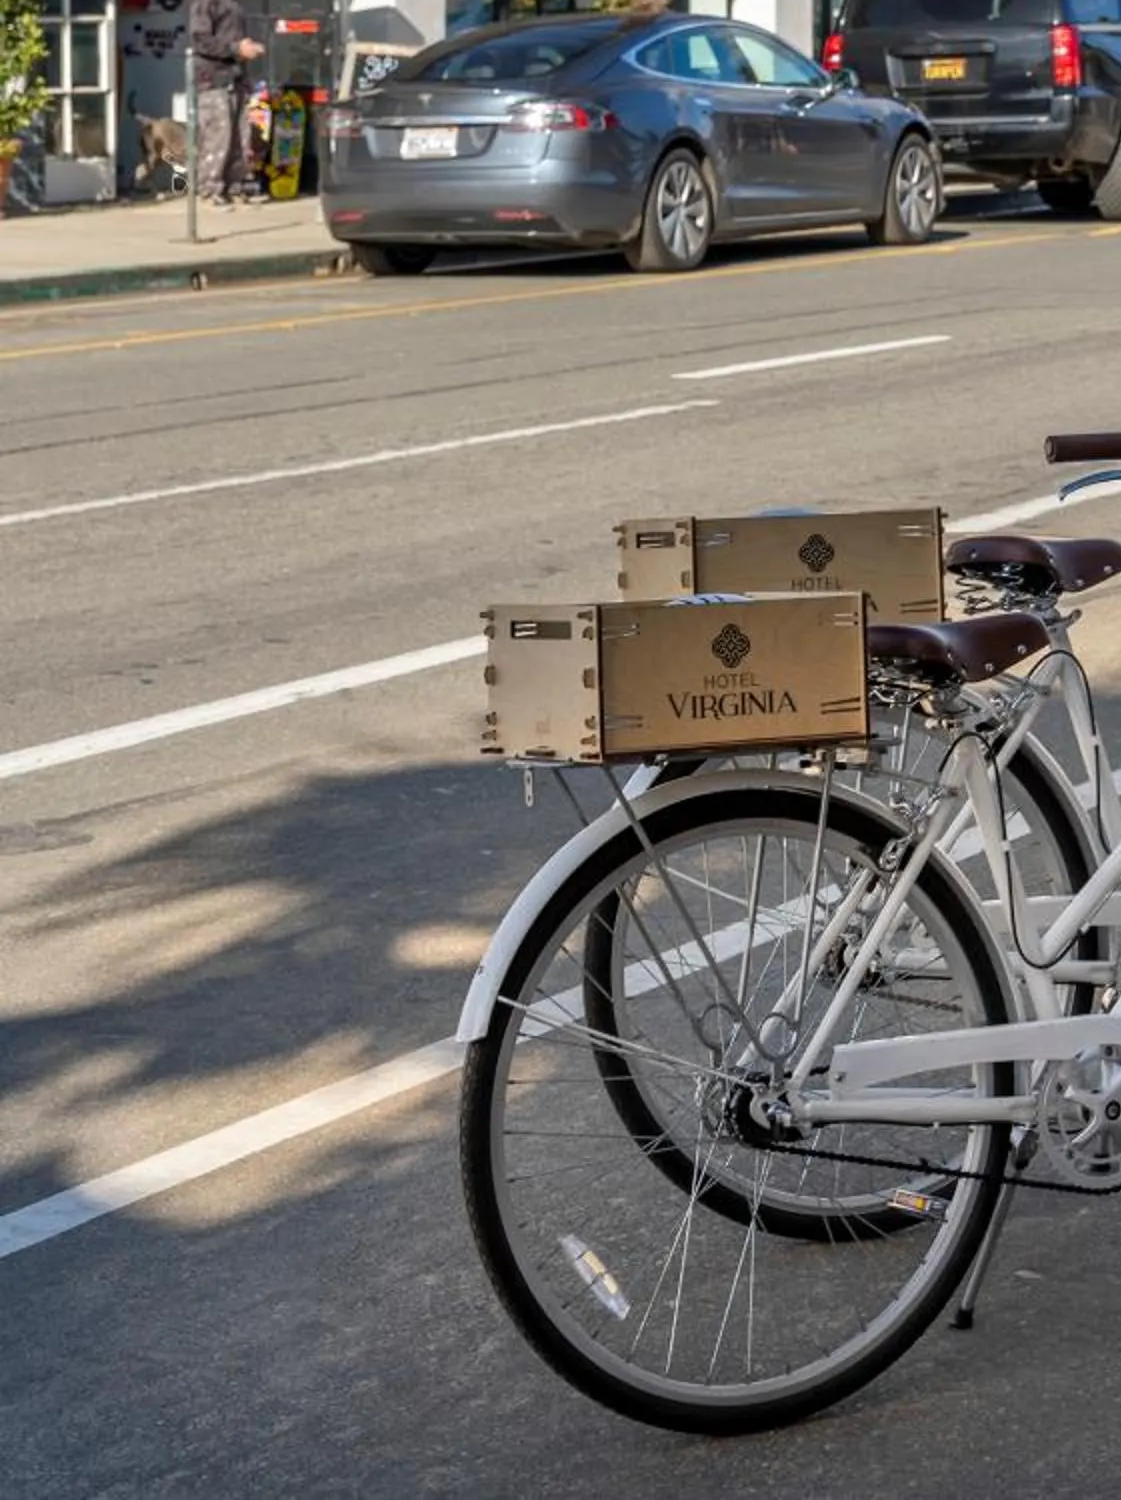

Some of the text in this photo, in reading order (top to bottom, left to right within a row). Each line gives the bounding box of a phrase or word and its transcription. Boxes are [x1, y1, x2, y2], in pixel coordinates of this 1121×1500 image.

[791, 576, 843, 591] HOTEL
[704, 673, 760, 689] HOTEL
[667, 690, 797, 720] VIRGINIA
